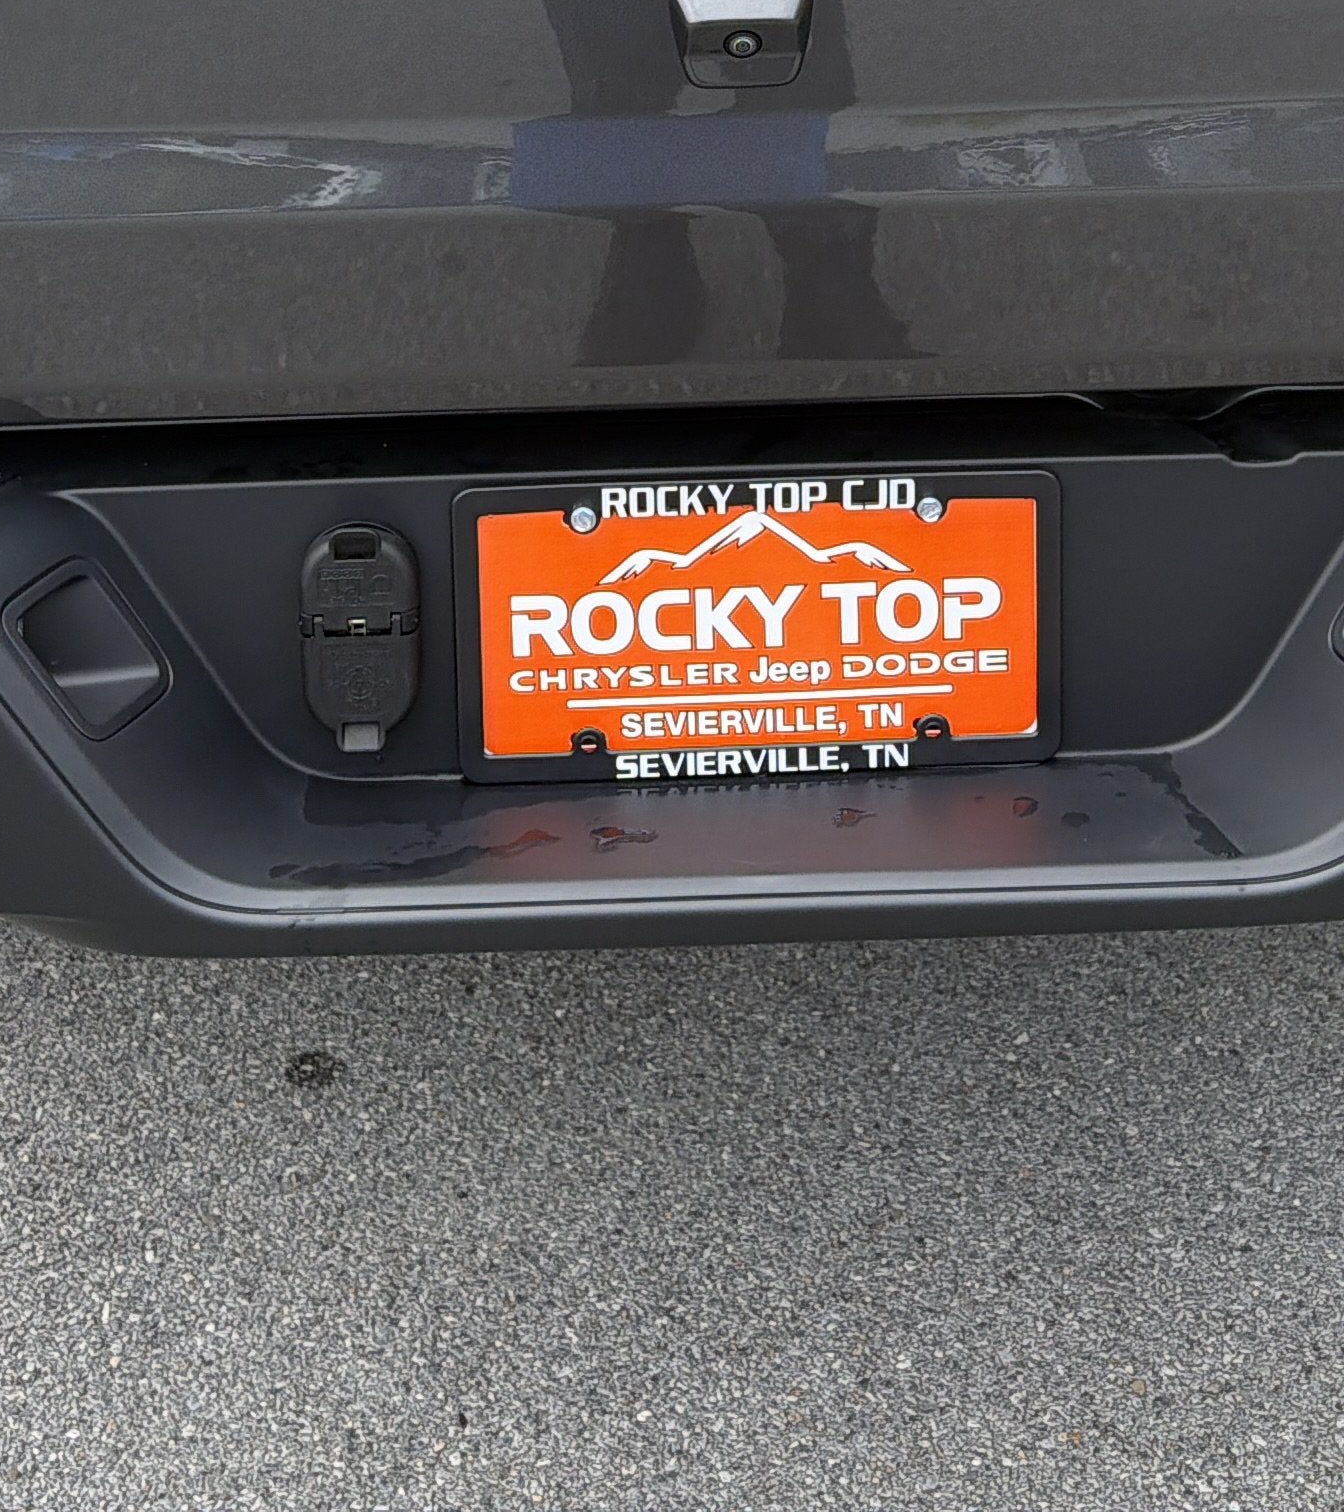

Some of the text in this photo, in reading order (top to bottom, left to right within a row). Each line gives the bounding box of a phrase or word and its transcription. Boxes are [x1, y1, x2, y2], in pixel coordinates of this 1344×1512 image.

[601, 478, 915, 518] ROCKY TOP CJD
[510, 576, 1002, 658] ROCKY TOP
[509, 649, 1009, 692] CHRYSLER Jeep DODGE
[620, 702, 904, 739] SEVIERVILLE, TN
[615, 743, 909, 780] SEVIERVILLE, TN
